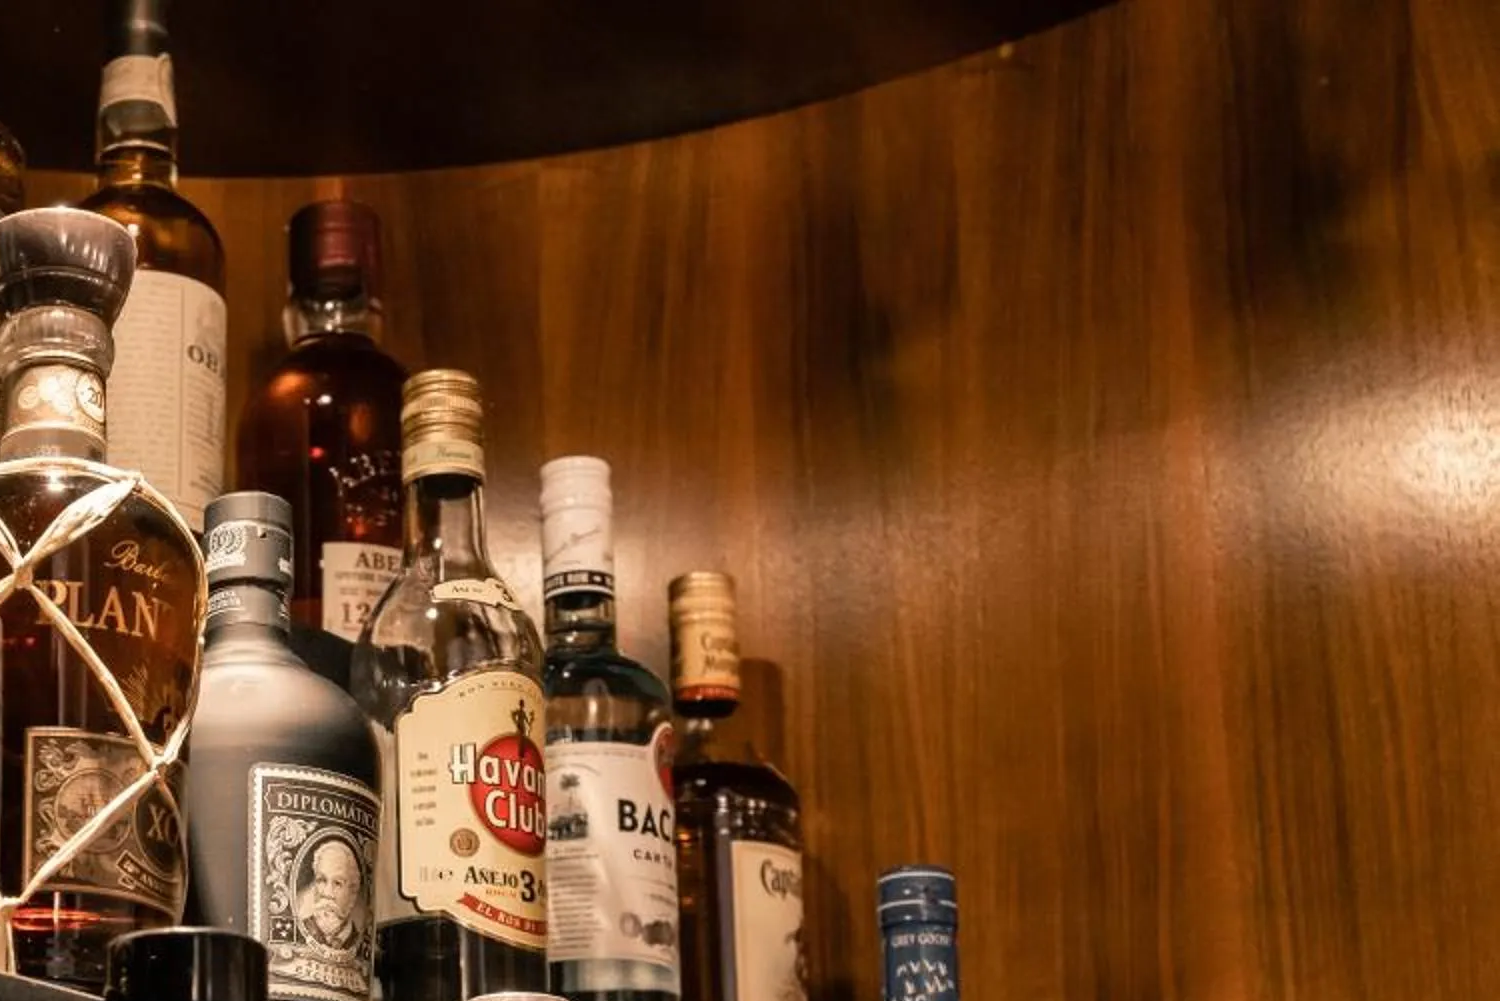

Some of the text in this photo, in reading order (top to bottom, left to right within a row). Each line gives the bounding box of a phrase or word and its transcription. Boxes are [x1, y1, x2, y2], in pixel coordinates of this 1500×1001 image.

[484, 789, 545, 839] Club
[463, 865, 519, 889] AÑEJO
[520, 869, 538, 902] 3
